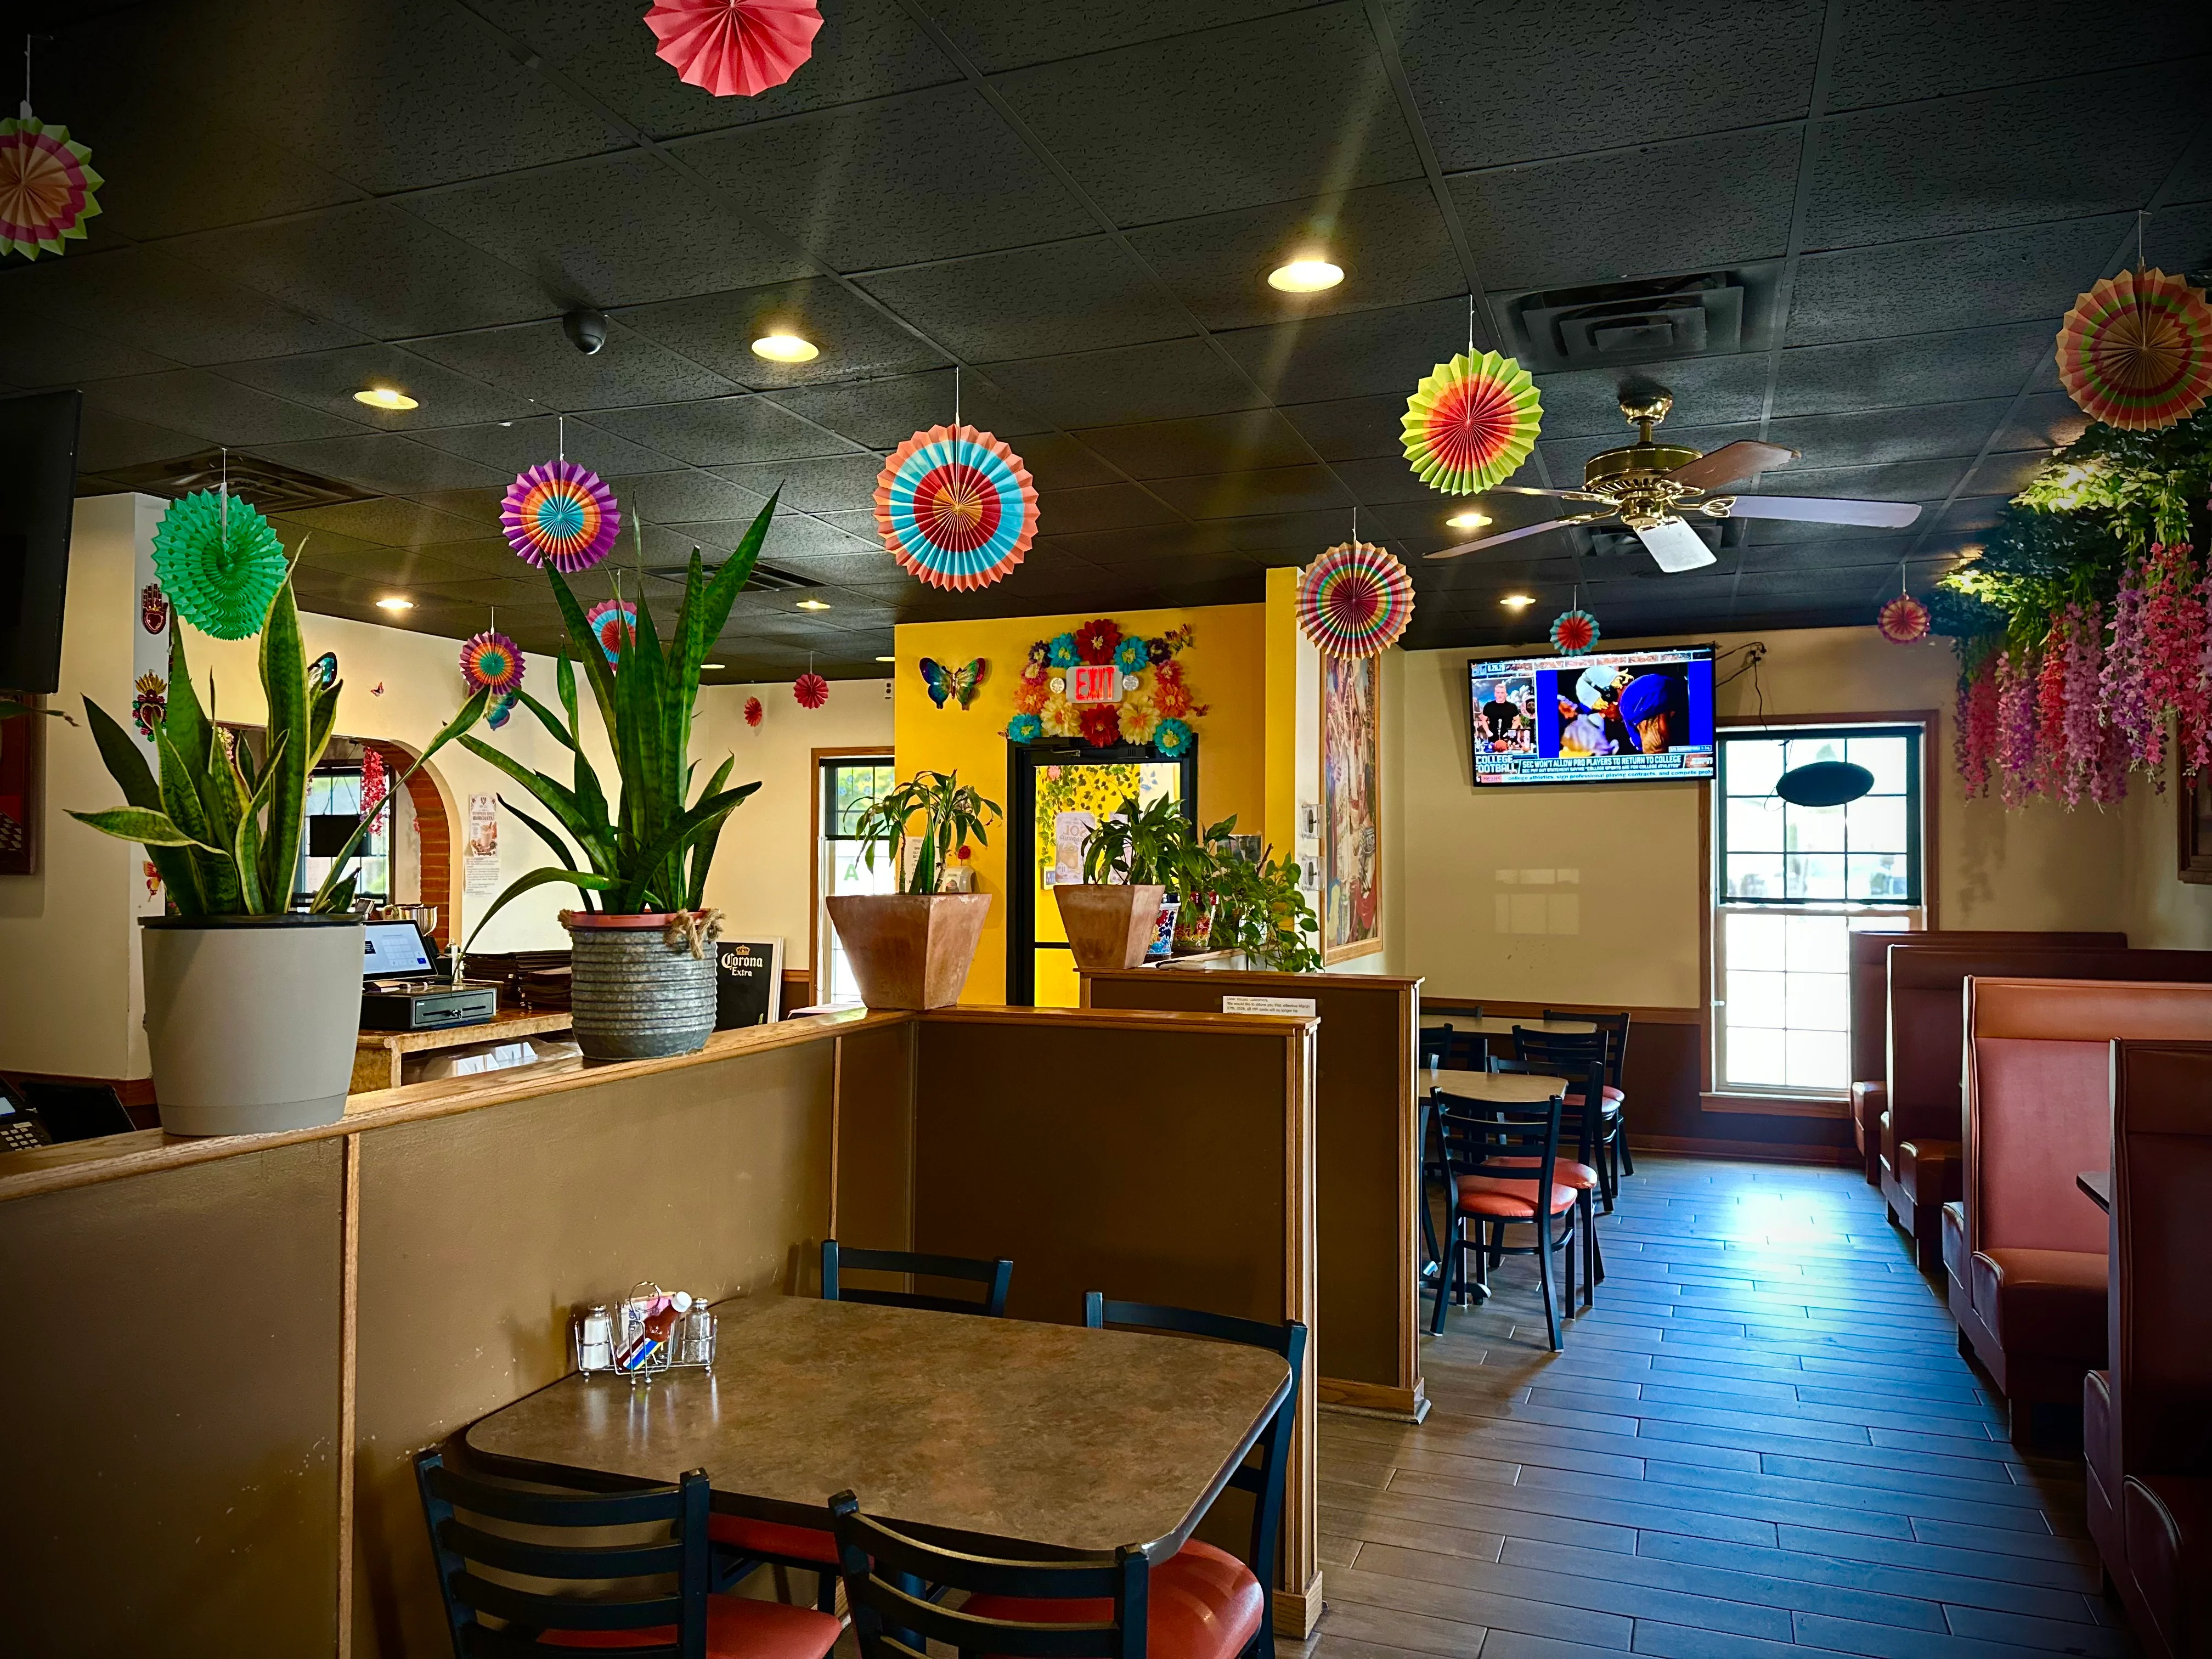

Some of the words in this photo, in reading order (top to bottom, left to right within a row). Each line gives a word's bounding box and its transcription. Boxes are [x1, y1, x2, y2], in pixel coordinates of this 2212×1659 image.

[1076, 667, 1115, 701] EXIT
[1475, 754, 1513, 764] COLLEGE
[1534, 759, 1553, 768] WON'T
[1553, 759, 1573, 767] ALLOW
[1586, 758, 1612, 766] PLAYERS
[1621, 757, 1645, 765] RETURN
[1655, 755, 1681, 763] COLLEGE
[844, 864, 859, 881] A
[721, 952, 763, 970] Corona
[731, 967, 752, 977] Extra
